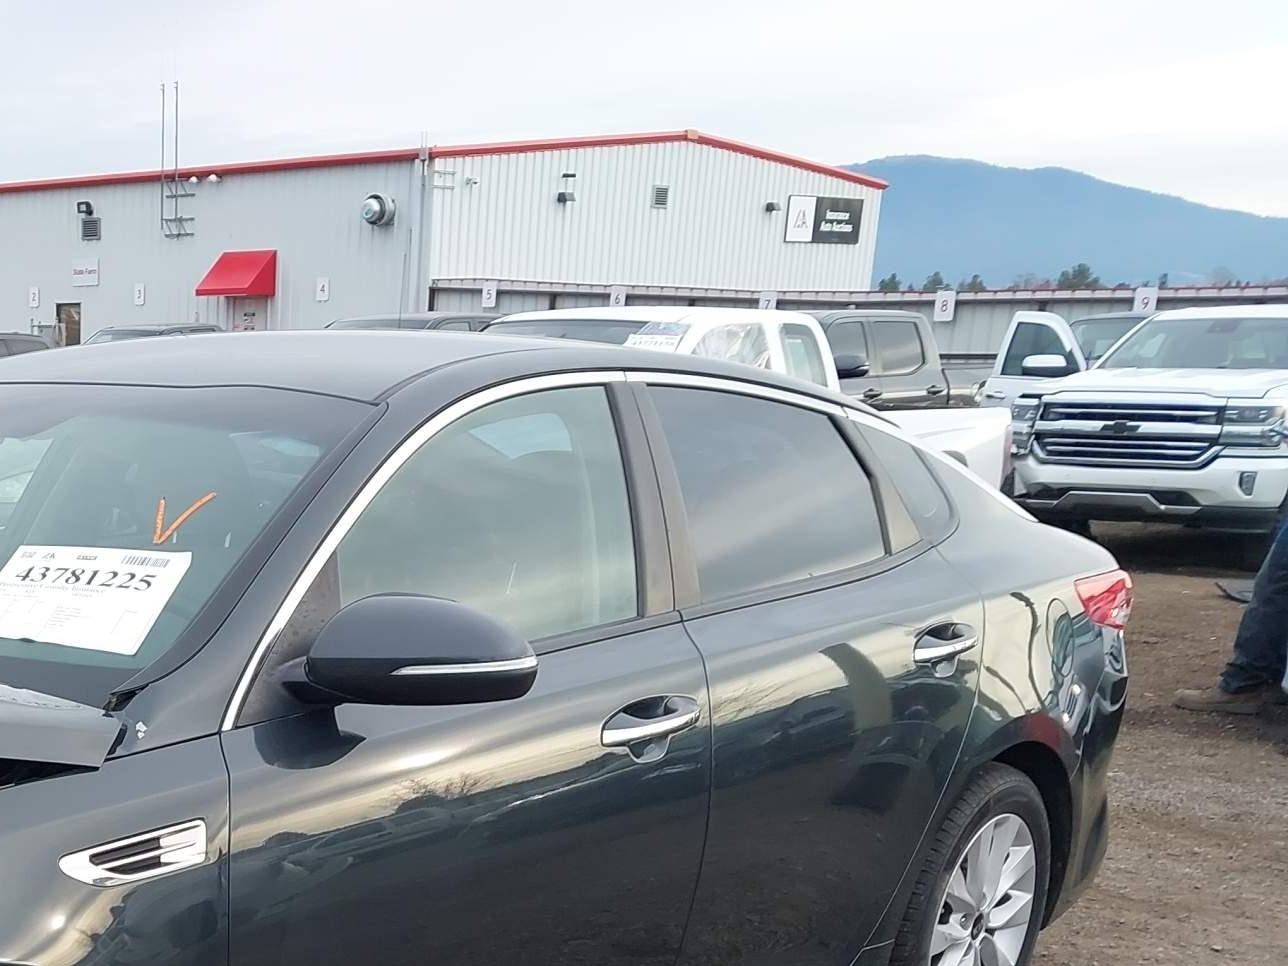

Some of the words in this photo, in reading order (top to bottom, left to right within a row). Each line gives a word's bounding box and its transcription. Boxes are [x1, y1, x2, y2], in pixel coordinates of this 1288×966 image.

[319, 283, 325, 294] 4
[486, 289, 493, 300] 5
[615, 294, 621, 305] 6
[764, 299, 771, 310] 7
[940, 299, 949, 312] 8
[1142, 296, 1150, 310] 9
[15, 565, 158, 592] 43781225
